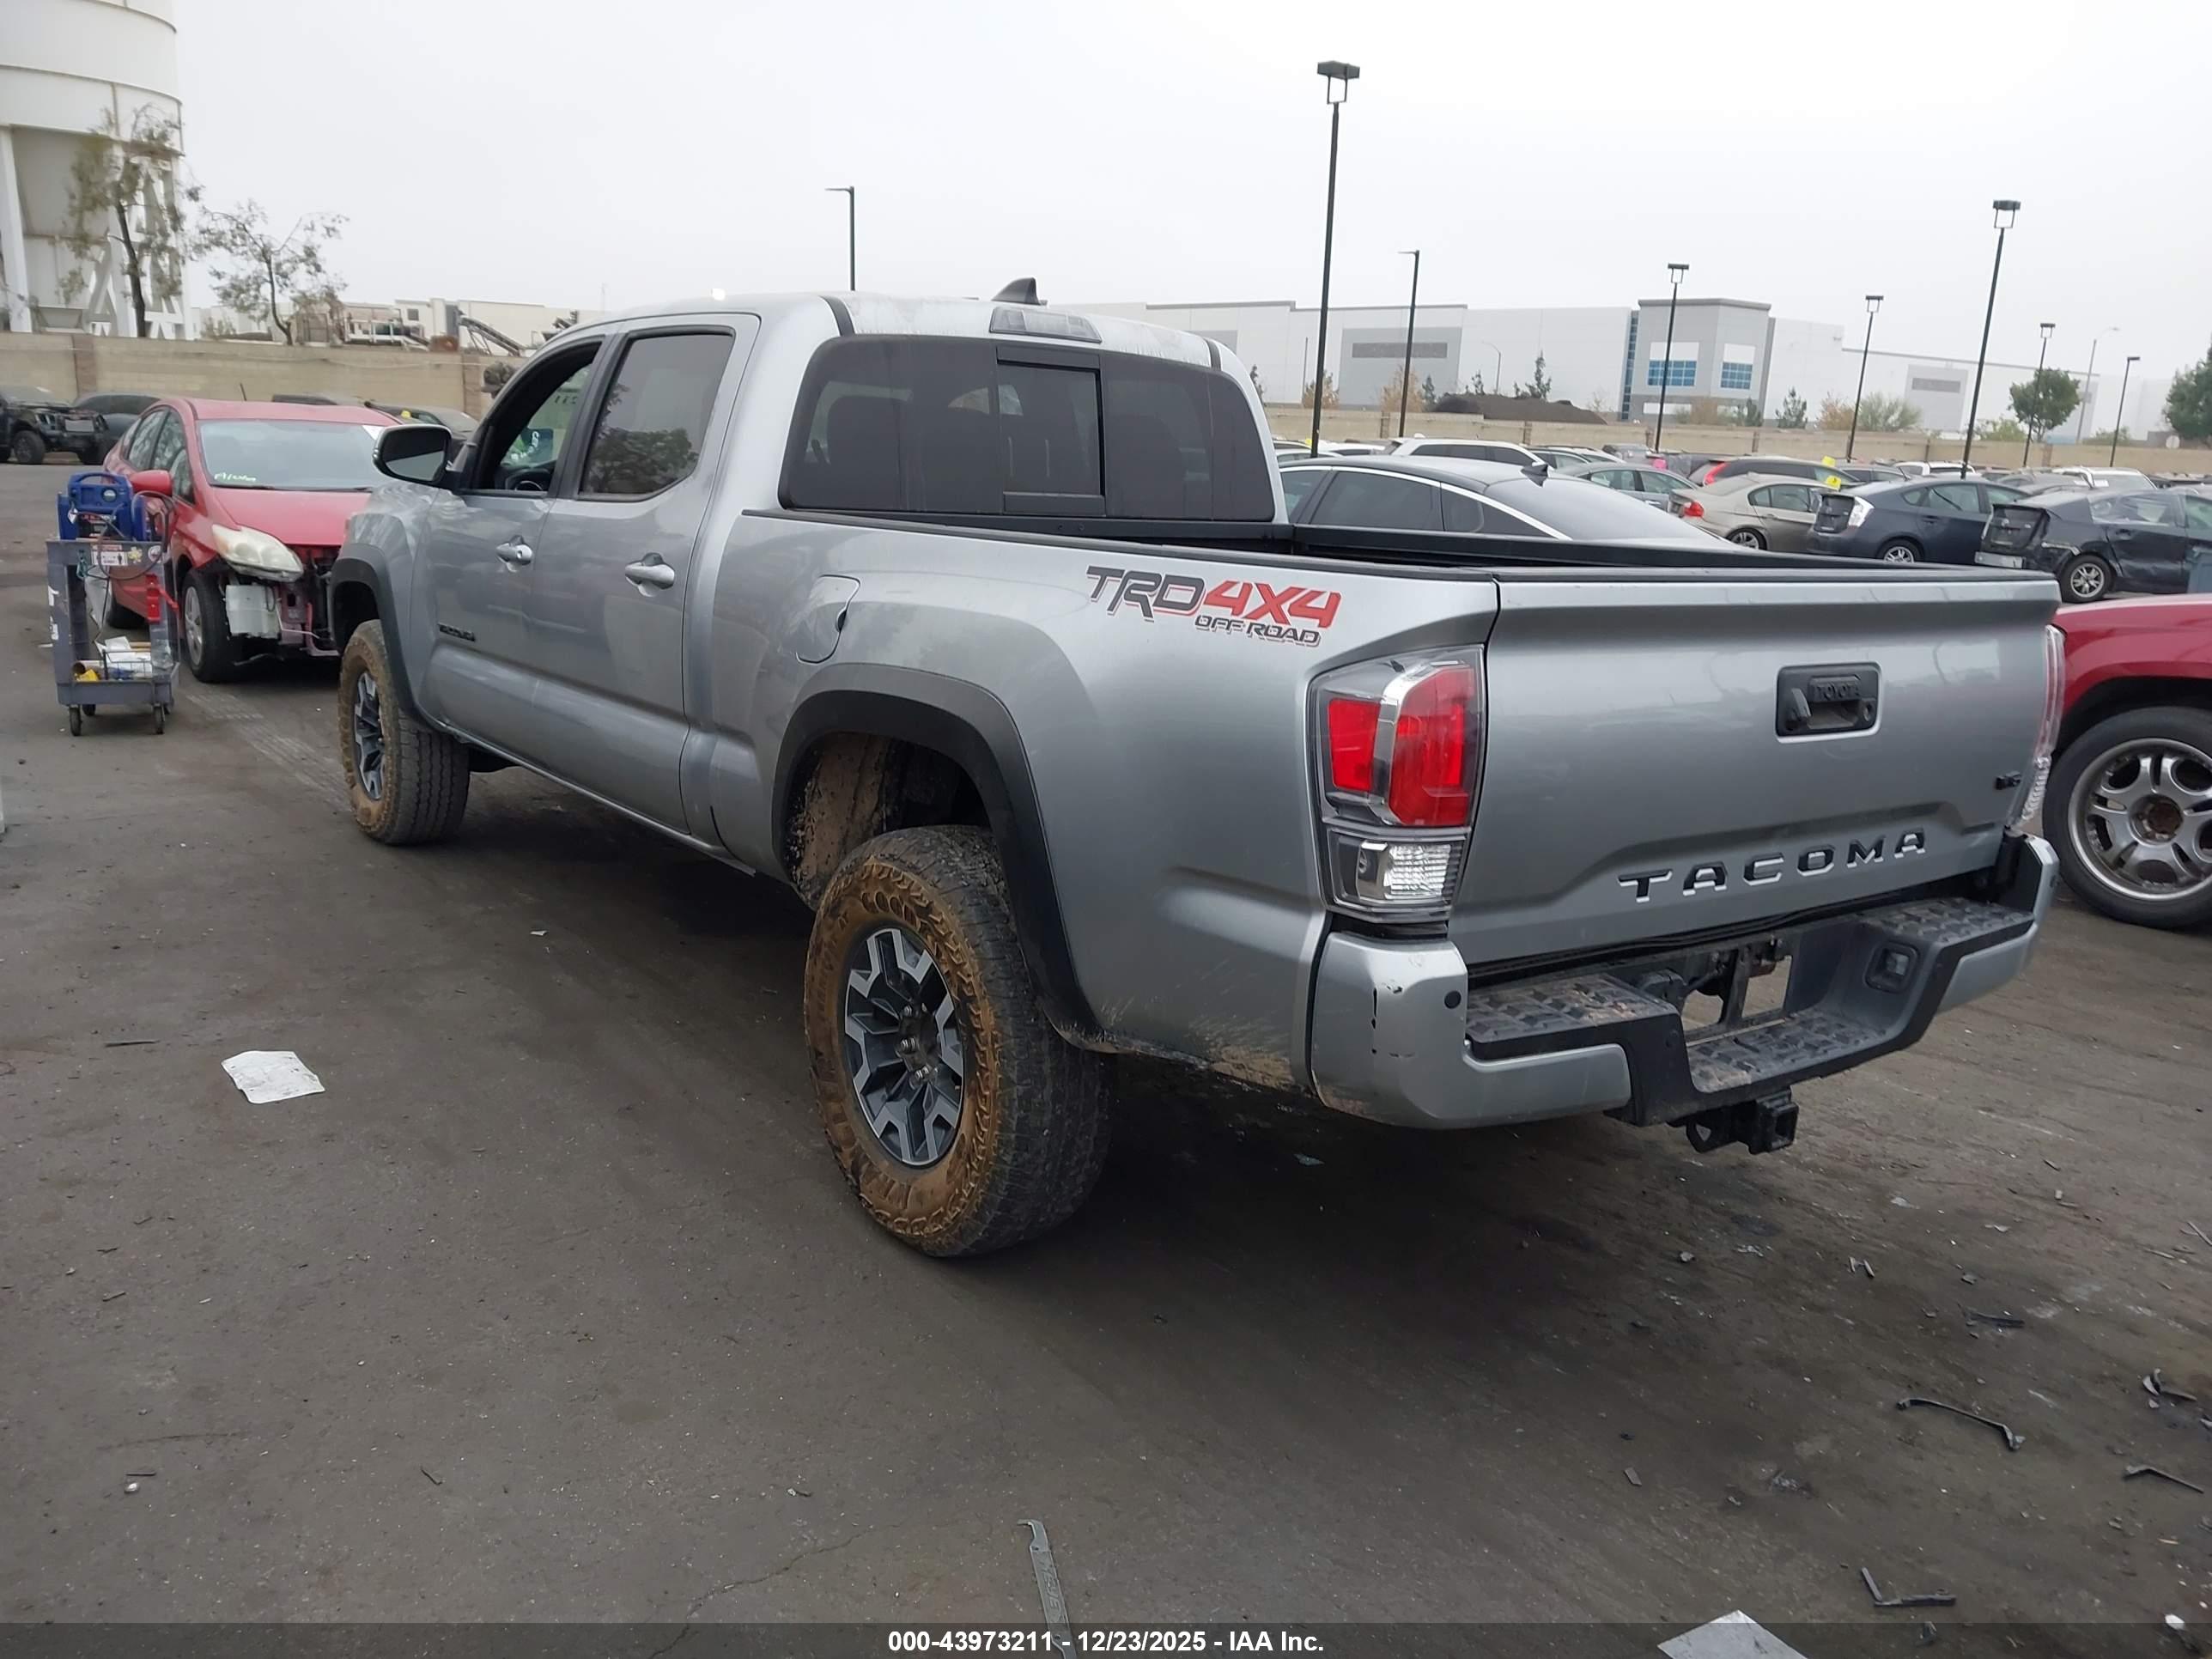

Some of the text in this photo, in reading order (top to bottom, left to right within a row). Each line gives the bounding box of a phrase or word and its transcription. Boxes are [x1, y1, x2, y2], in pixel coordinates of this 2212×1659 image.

[1194, 614, 1322, 647] OFF ROAD
[1618, 826, 1928, 904] TACOMA
